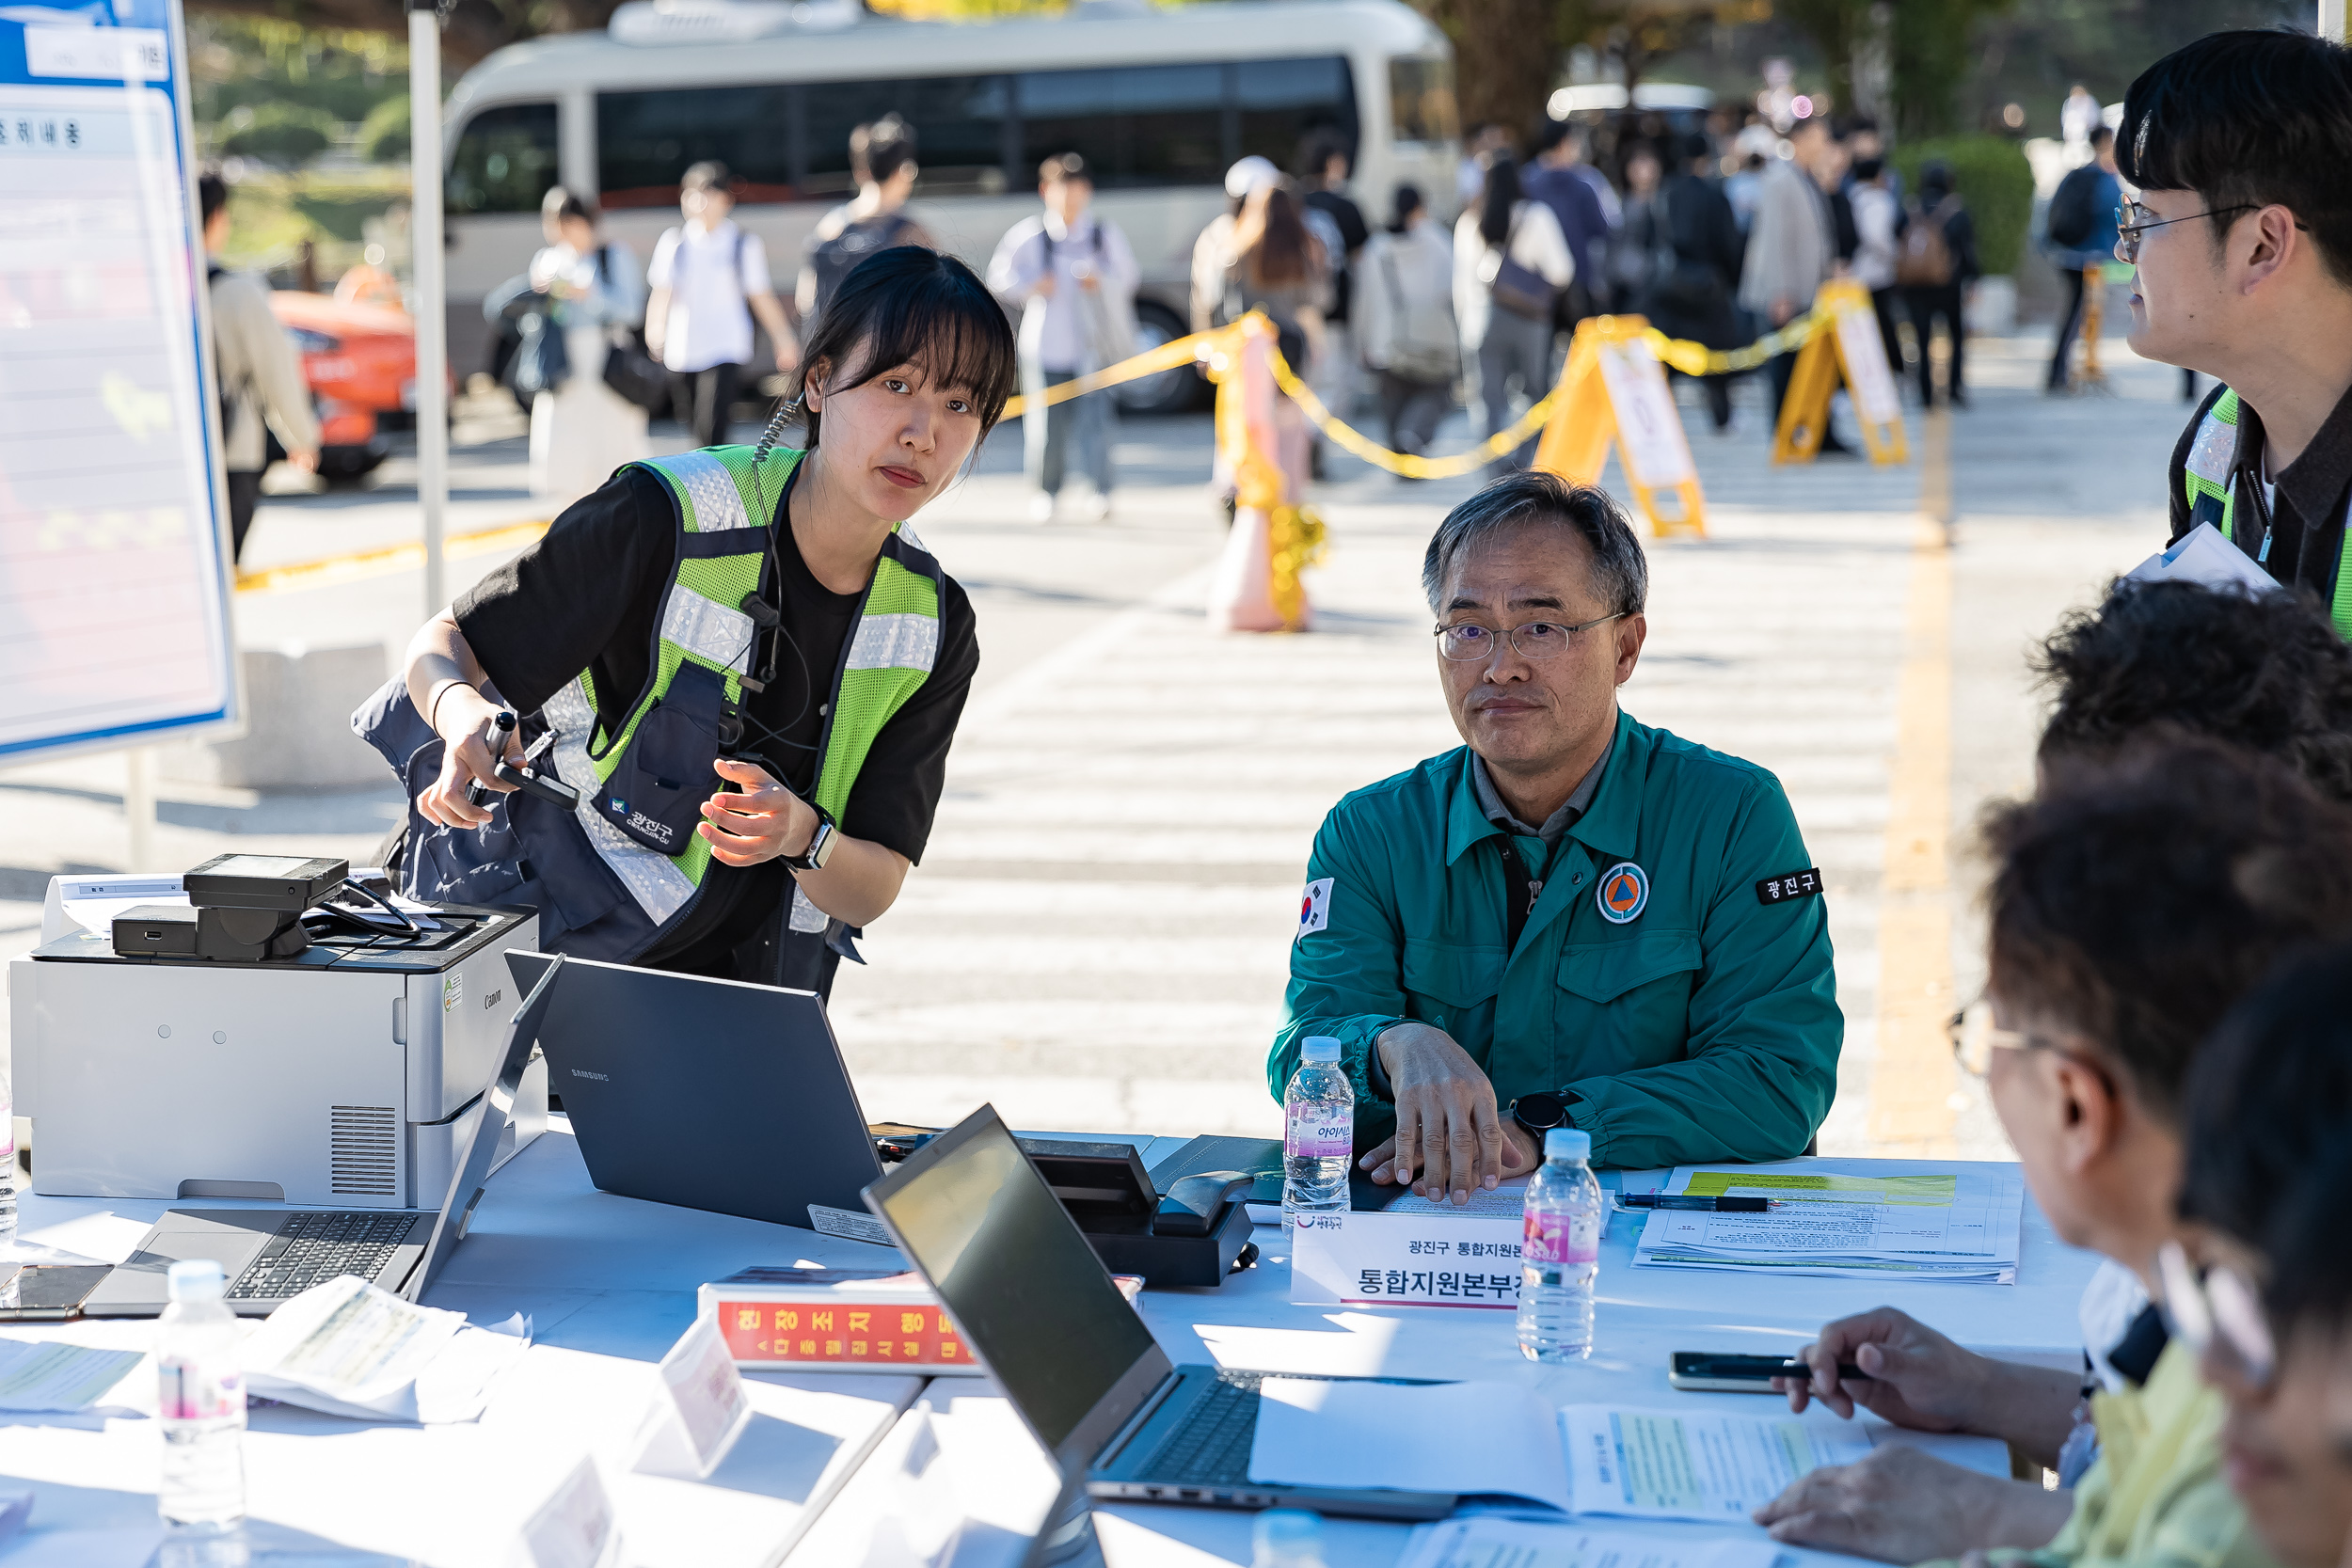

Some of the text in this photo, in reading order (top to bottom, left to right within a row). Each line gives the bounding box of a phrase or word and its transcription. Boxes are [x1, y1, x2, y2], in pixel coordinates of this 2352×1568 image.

[626, 818, 670, 845] GWANGJIN-GU
[631, 811, 674, 837] 광진구
[1767, 873, 1815, 899] 광진구
[485, 990, 501, 1010] Canon
[571, 1069, 610, 1082] SAMSUNG
[1409, 1240, 1450, 1255] 광진구
